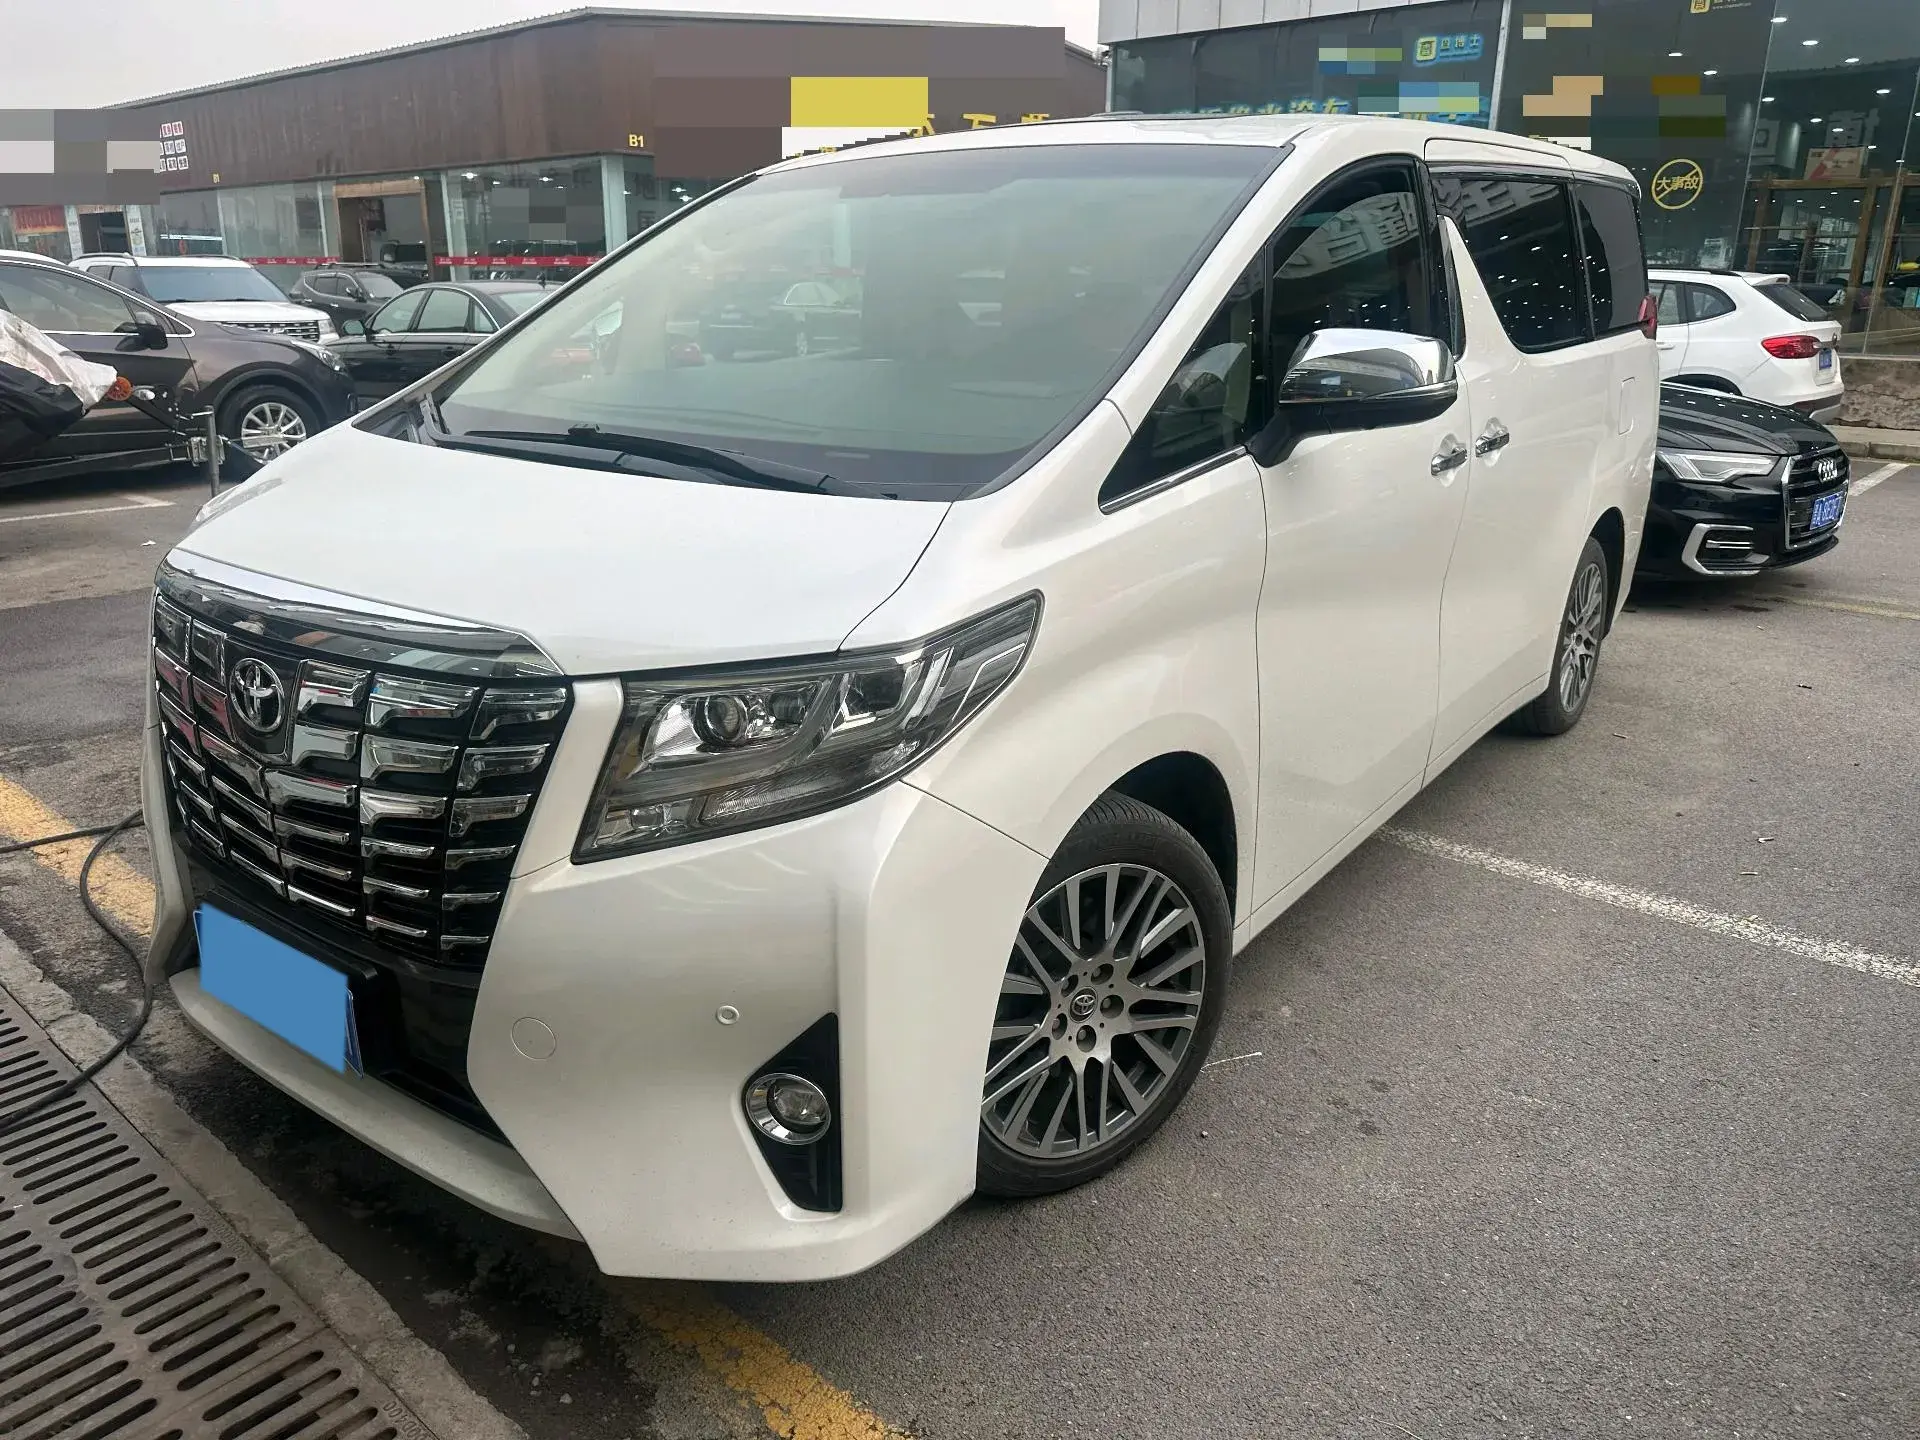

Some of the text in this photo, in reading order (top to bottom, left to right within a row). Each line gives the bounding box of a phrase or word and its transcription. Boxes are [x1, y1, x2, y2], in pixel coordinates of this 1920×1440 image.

[629, 134, 644, 148] B1
[1656, 176, 1699, 191] 大事故
